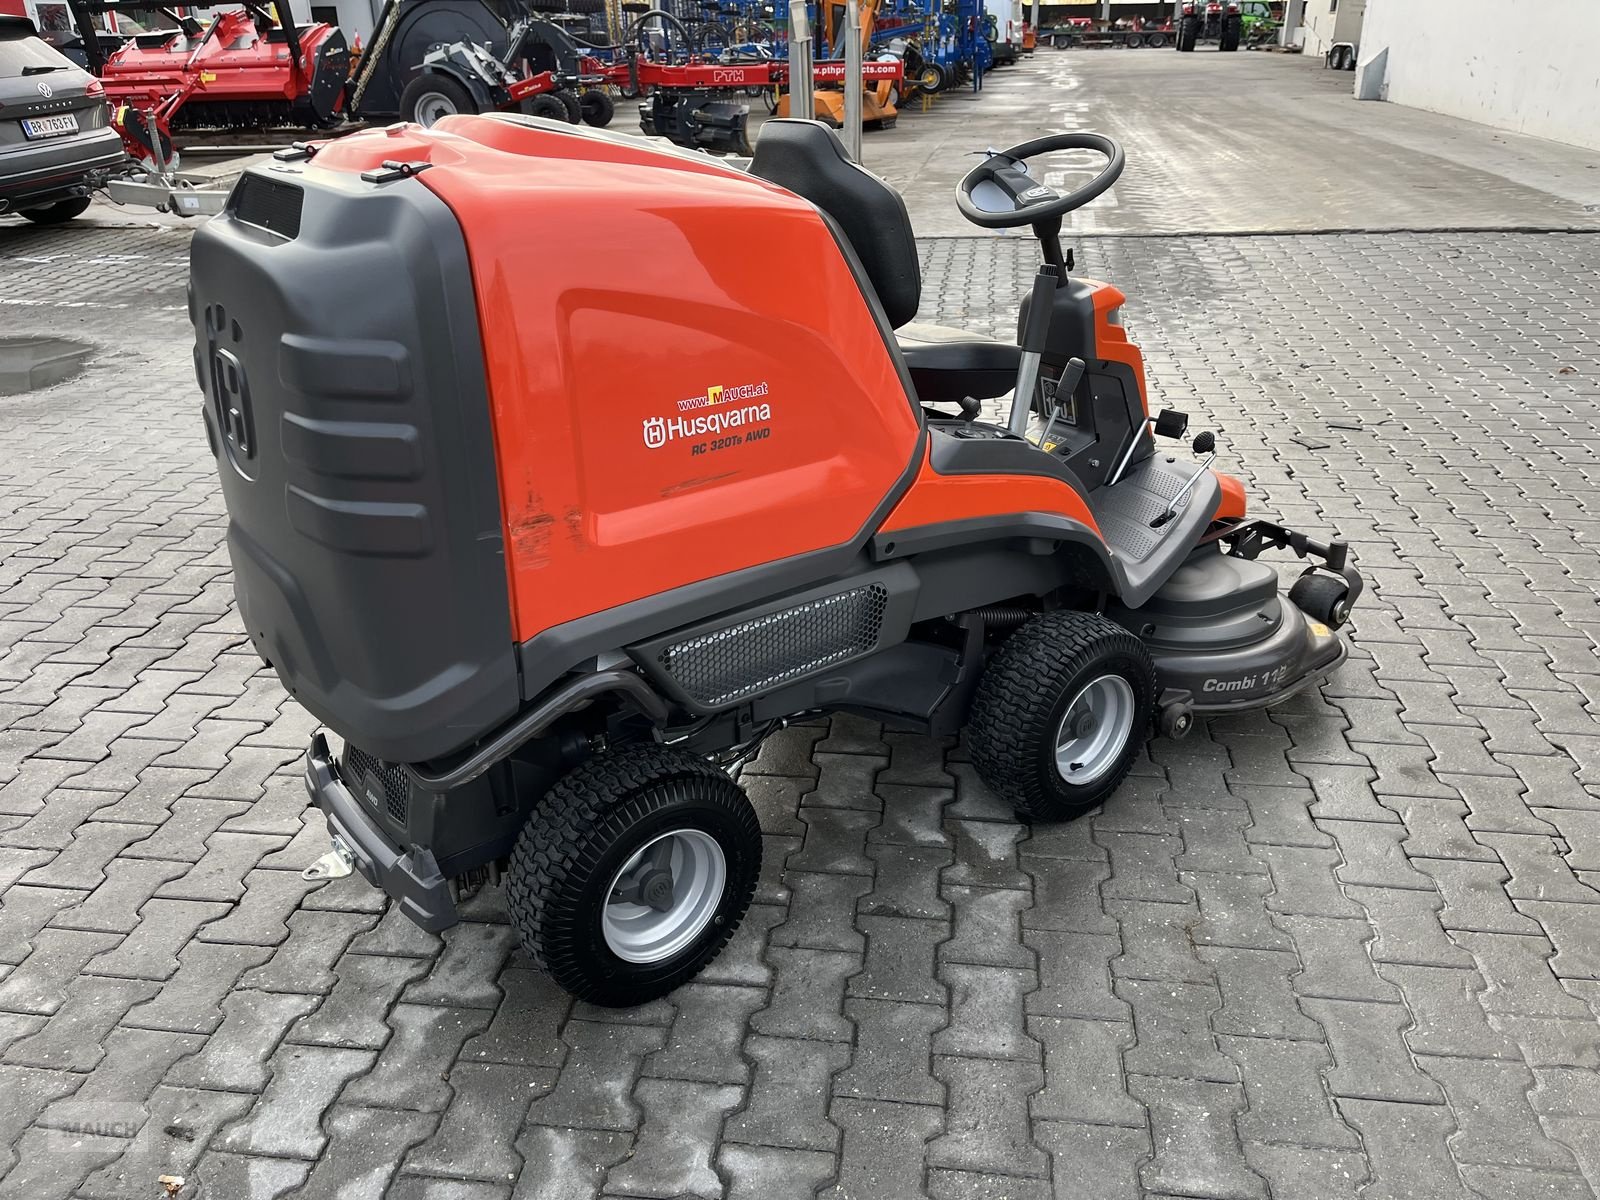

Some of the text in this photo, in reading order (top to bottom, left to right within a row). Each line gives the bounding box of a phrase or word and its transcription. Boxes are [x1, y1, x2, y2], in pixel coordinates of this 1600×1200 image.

[713, 69, 744, 82] PTH
[31, 120, 44, 133] BR
[677, 382, 768, 411] www.MAUCH.at
[667, 403, 771, 440] Husqvarna
[691, 443, 707, 456] RC
[745, 428, 770, 443] AWD
[1202, 675, 1257, 692] Combi
